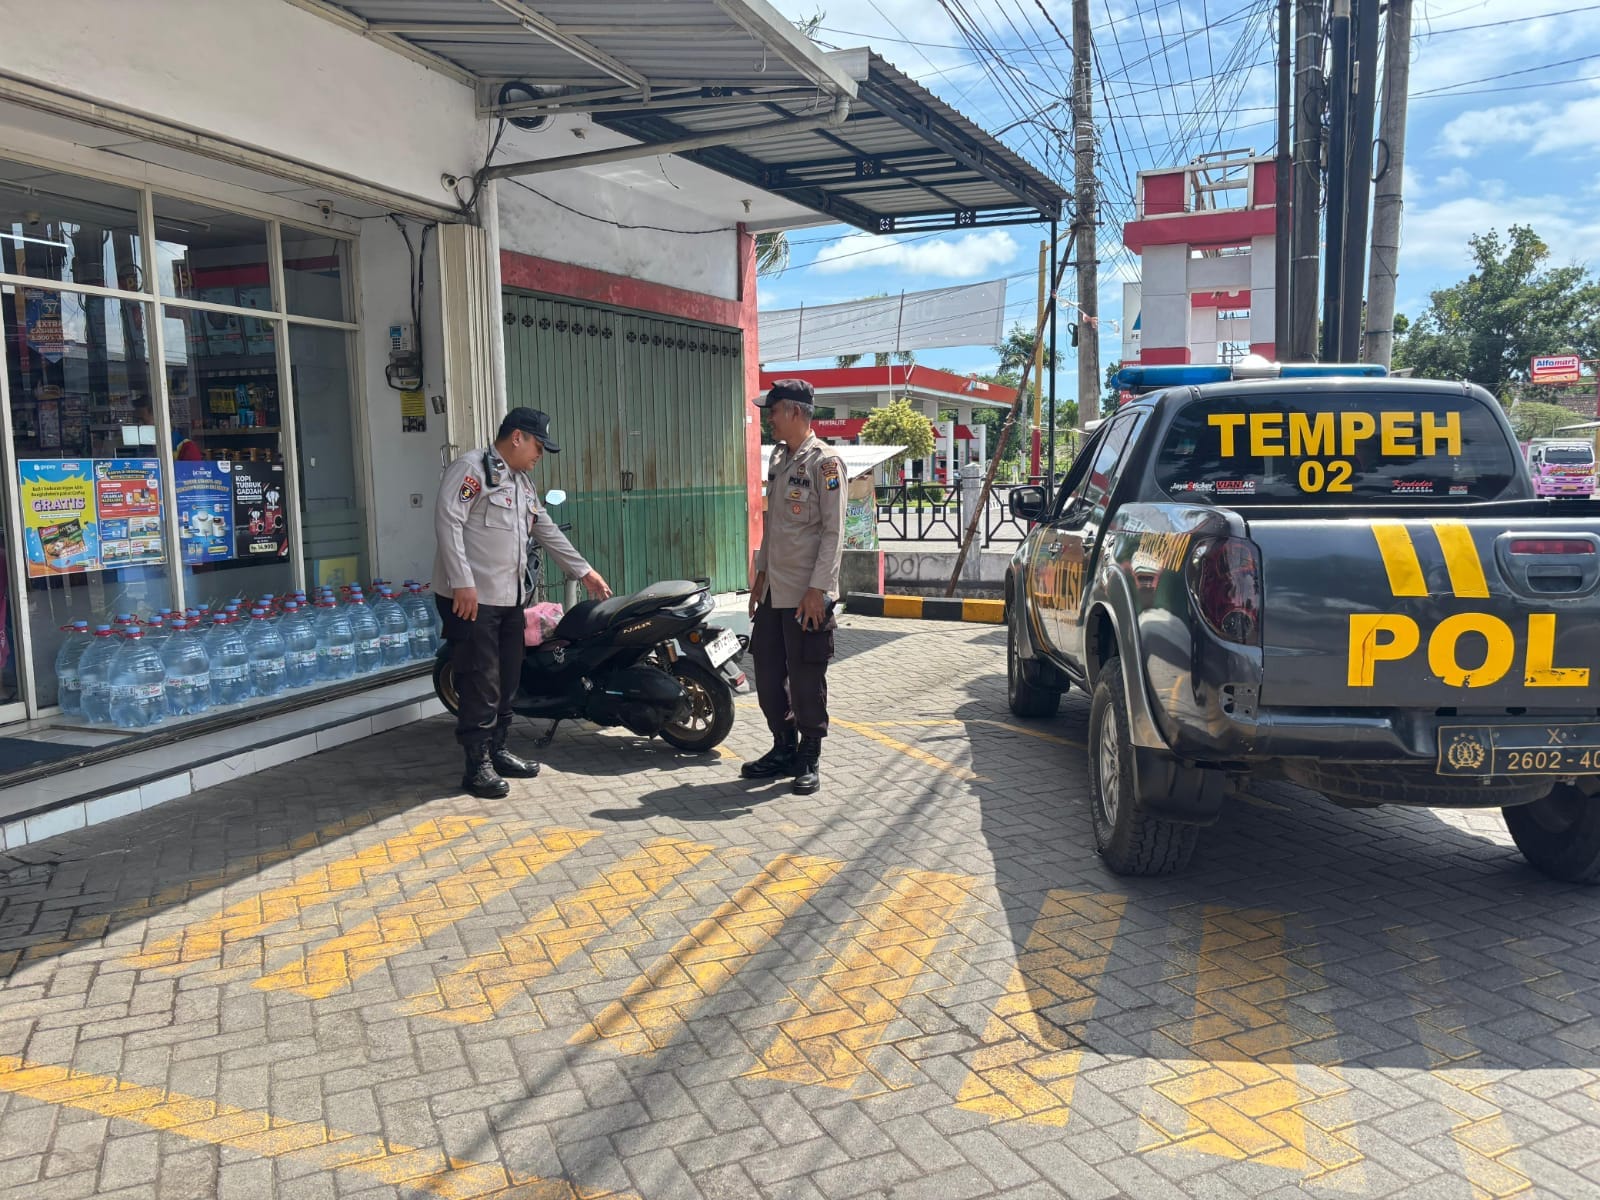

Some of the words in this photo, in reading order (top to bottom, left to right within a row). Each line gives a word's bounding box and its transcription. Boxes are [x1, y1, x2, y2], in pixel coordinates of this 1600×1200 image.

[1536, 359, 1575, 367] Alfamart
[1207, 411, 1462, 457] TEMPEH
[788, 475, 810, 488] POLRI
[1299, 460, 1353, 493] 02
[32, 497, 86, 513] GRATIS
[1347, 612, 1590, 688] POL
[1547, 728, 1563, 744] X
